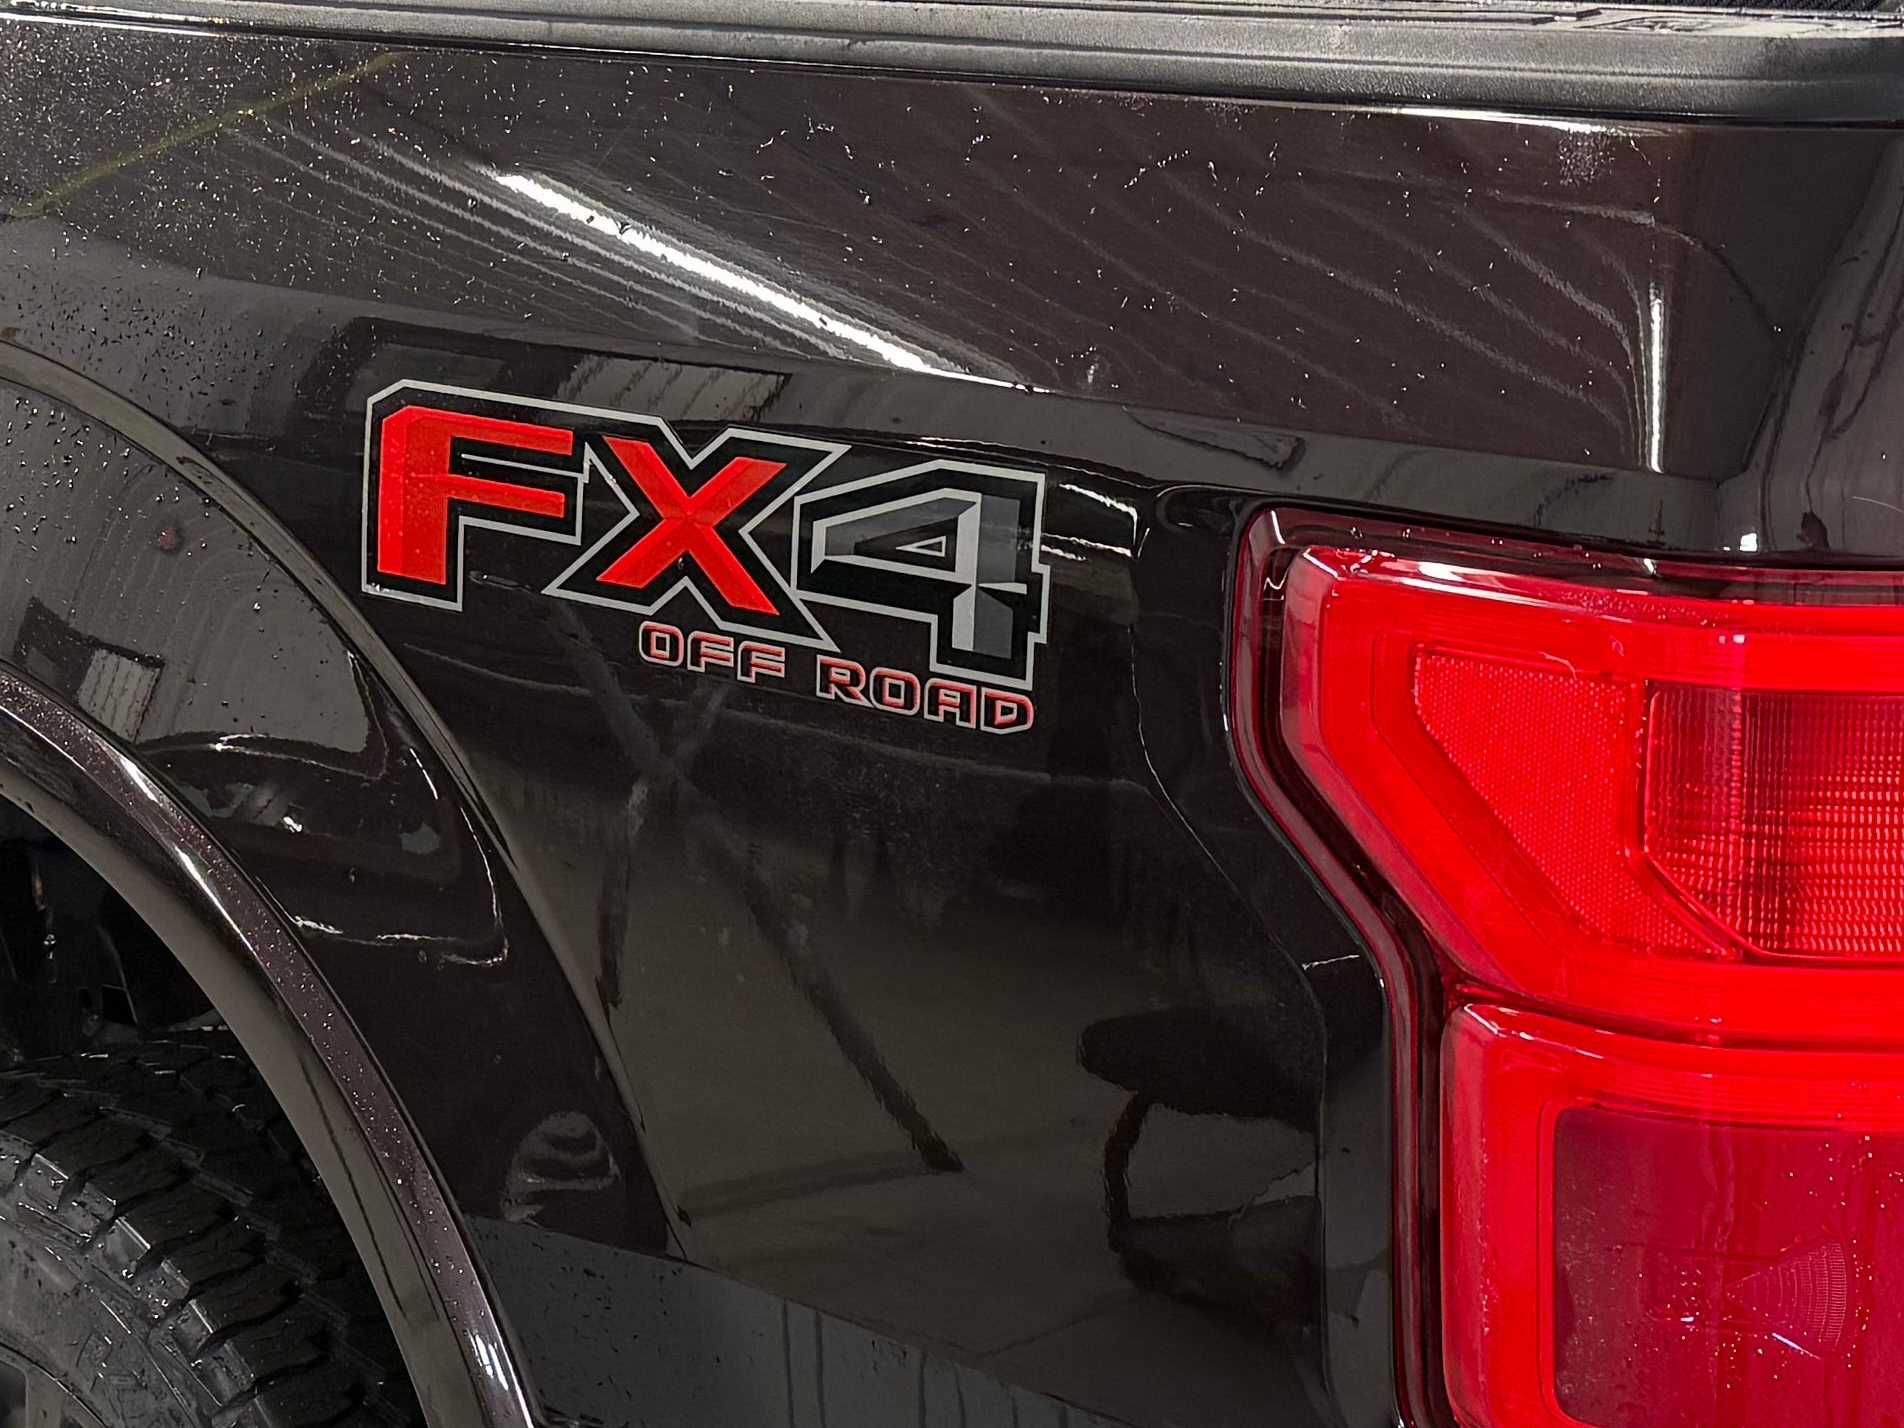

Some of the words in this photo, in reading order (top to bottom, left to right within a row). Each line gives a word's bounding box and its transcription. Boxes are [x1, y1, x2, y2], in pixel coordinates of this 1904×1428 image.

[362, 379, 1050, 690] FX4
[639, 621, 786, 683] OFF
[815, 656, 1034, 735] ROAD
